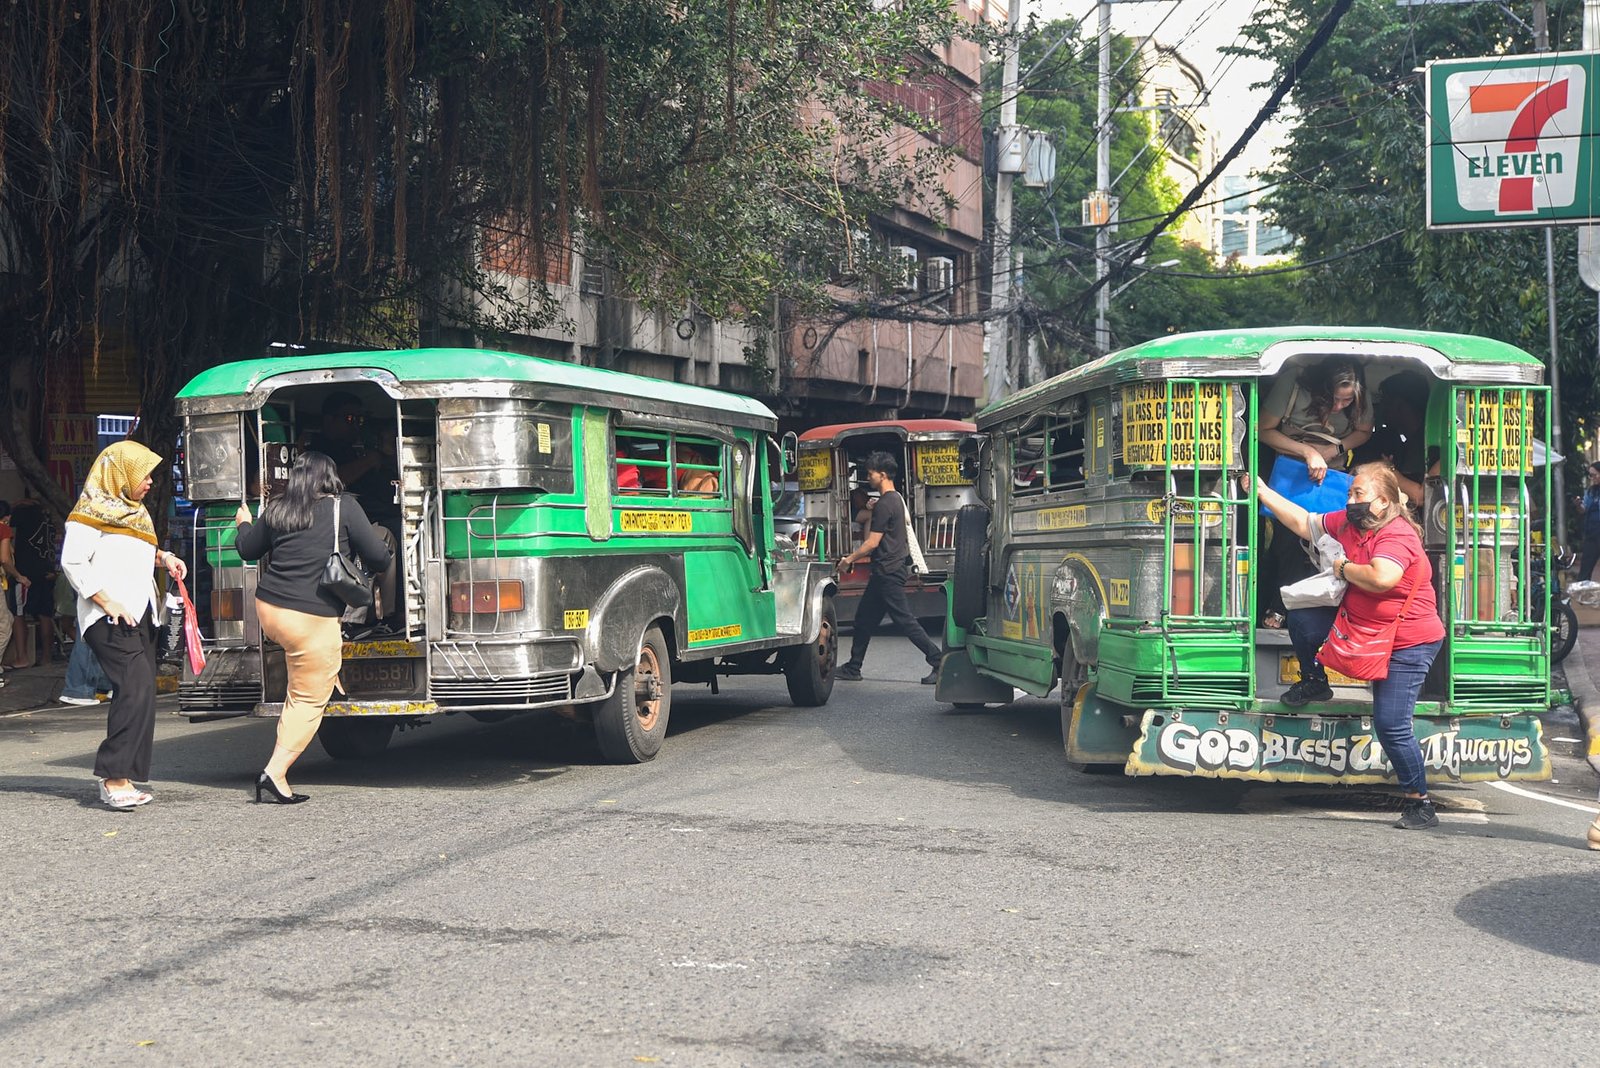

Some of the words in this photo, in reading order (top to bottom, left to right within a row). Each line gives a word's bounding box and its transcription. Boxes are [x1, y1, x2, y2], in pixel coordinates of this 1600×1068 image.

[1469, 78, 1569, 212] 7
[1138, 422, 1164, 442] VIBER
[1171, 422, 1222, 441] OTLNES
[1503, 407, 1521, 427] ASS
[1158, 721, 1260, 770] GOD
[1349, 734, 1396, 774] U
